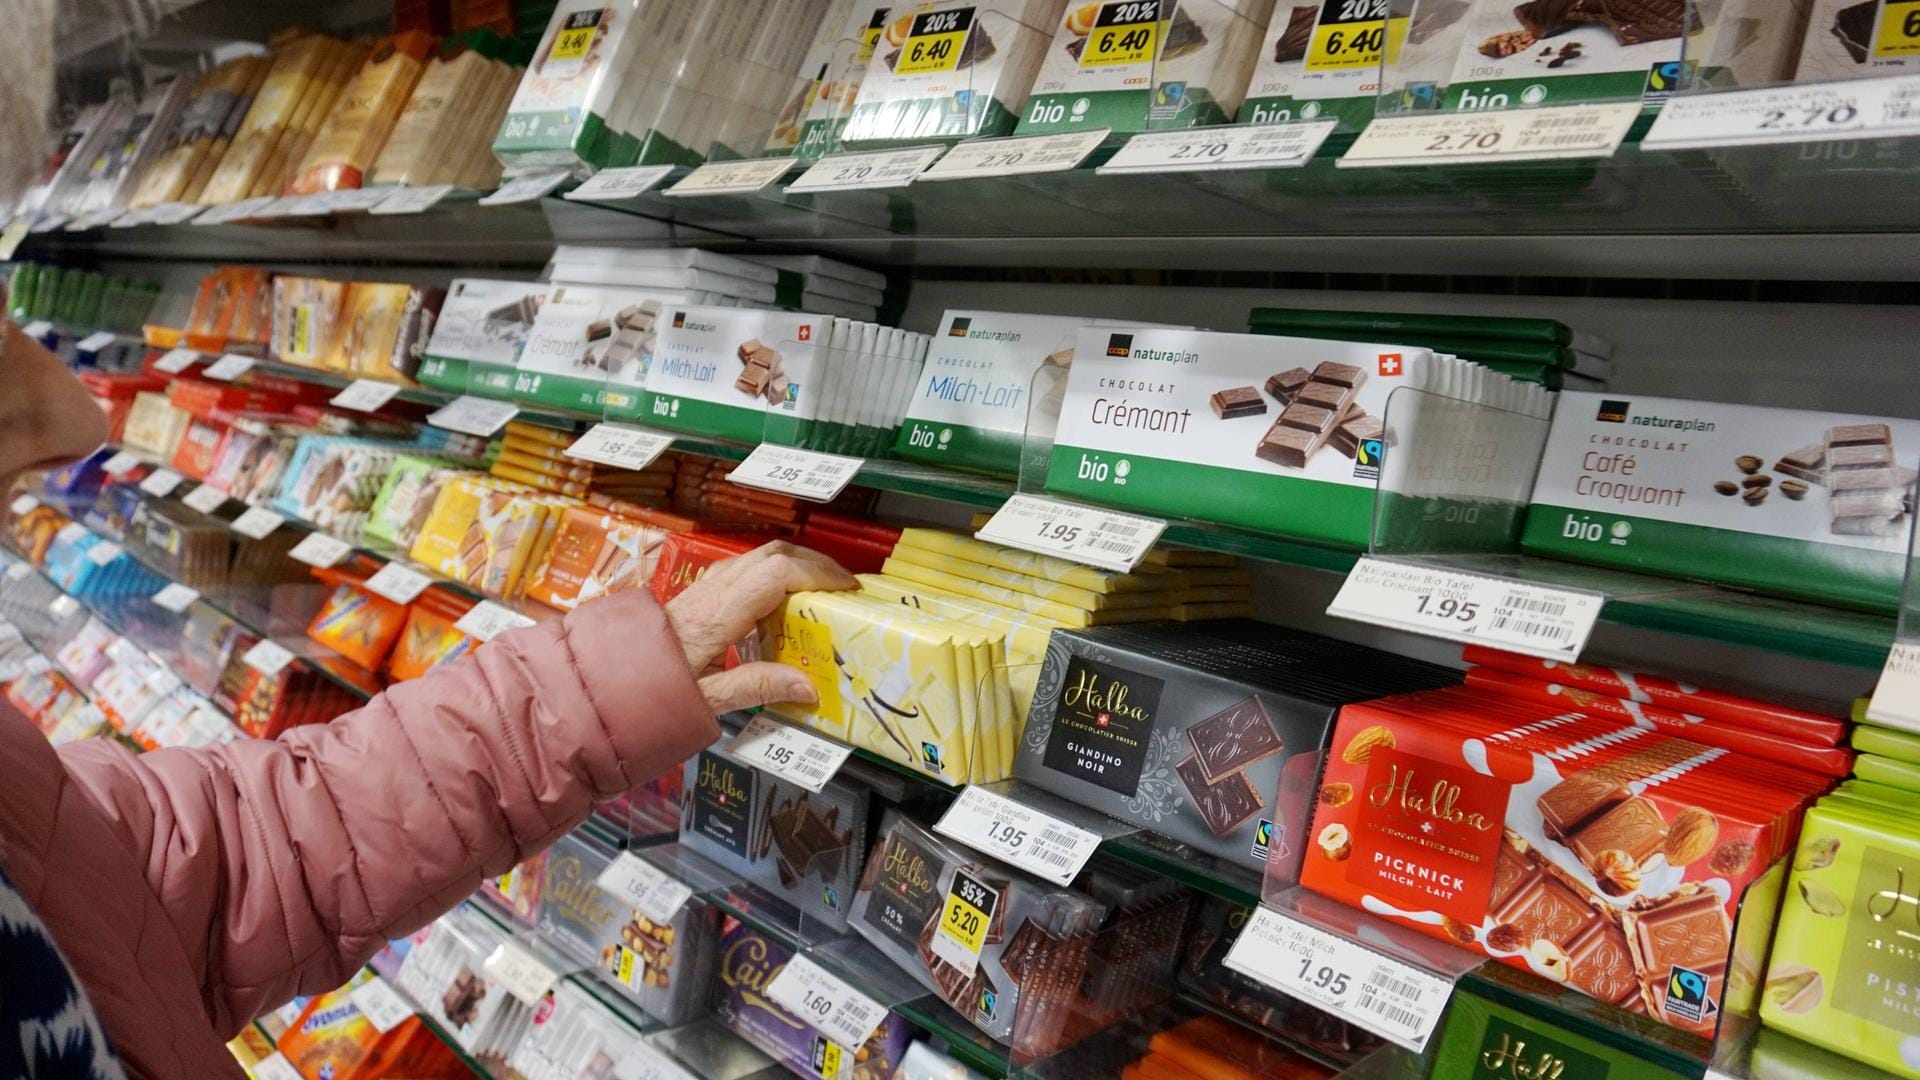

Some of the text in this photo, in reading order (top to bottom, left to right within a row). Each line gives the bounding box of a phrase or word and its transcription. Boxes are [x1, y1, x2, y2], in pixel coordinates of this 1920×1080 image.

[923, 10, 960, 34] 20%
[1113, 2, 1157, 23] 20%
[1339, 0, 1388, 21] 20%
[911, 38, 952, 62] 6.40
[1099, 28, 1149, 53] 6.40
[1325, 28, 1383, 56] 6.40
[1029, 99, 1064, 124] bio
[1457, 87, 1509, 113] bio
[1251, 102, 1291, 124] bio
[1756, 104, 1857, 129] 2.70
[505, 117, 527, 138] bio
[1169, 143, 1229, 160] 2.70
[1425, 132, 1502, 150] 2.70
[976, 153, 1024, 168] 2.70
[833, 166, 873, 181] 2.70
[970, 328, 1022, 344] naturaplan
[937, 357, 993, 370] CHOCOLAT
[1134, 348, 1199, 365] naturaplan
[1100, 378, 1176, 394] CHOCOLAT
[653, 396, 670, 416] bio
[1092, 398, 1192, 434] Crémant
[909, 423, 934, 448] bio
[1632, 414, 1716, 432] naturaplan
[601, 441, 624, 455] 1.95
[1590, 434, 1689, 452] CHOCOLAT
[767, 466, 802, 482] 2.95
[1078, 454, 1109, 482] bio
[1583, 451, 1637, 476] Café
[1576, 475, 1687, 507] Croquant
[1038, 521, 1082, 543] 1.95
[1562, 513, 1603, 542] bio
[670, 559, 705, 586] Hal
[1416, 595, 1480, 621] 1.95
[1065, 669, 1150, 722] Halba
[1070, 719, 1114, 740] CHOCOLATIER
[763, 743, 795, 765] 1.95
[1067, 741, 1123, 768] GIANDINO
[1077, 759, 1105, 775] NOIR
[700, 758, 748, 802] Halba
[1369, 764, 1494, 833] Halba
[988, 821, 1028, 848] 1.95
[884, 841, 933, 894] Halba
[1374, 851, 1464, 892] PICKNICK
[959, 878, 987, 908] 35%
[1379, 869, 1415, 888] MILCH
[1426, 885, 1454, 901] LAIT
[950, 904, 980, 937] 5.20
[721, 936, 784, 997] Cail
[1297, 958, 1352, 996] 1.95
[1360, 982, 1378, 996] 104
[801, 989, 832, 1016] 1.60
